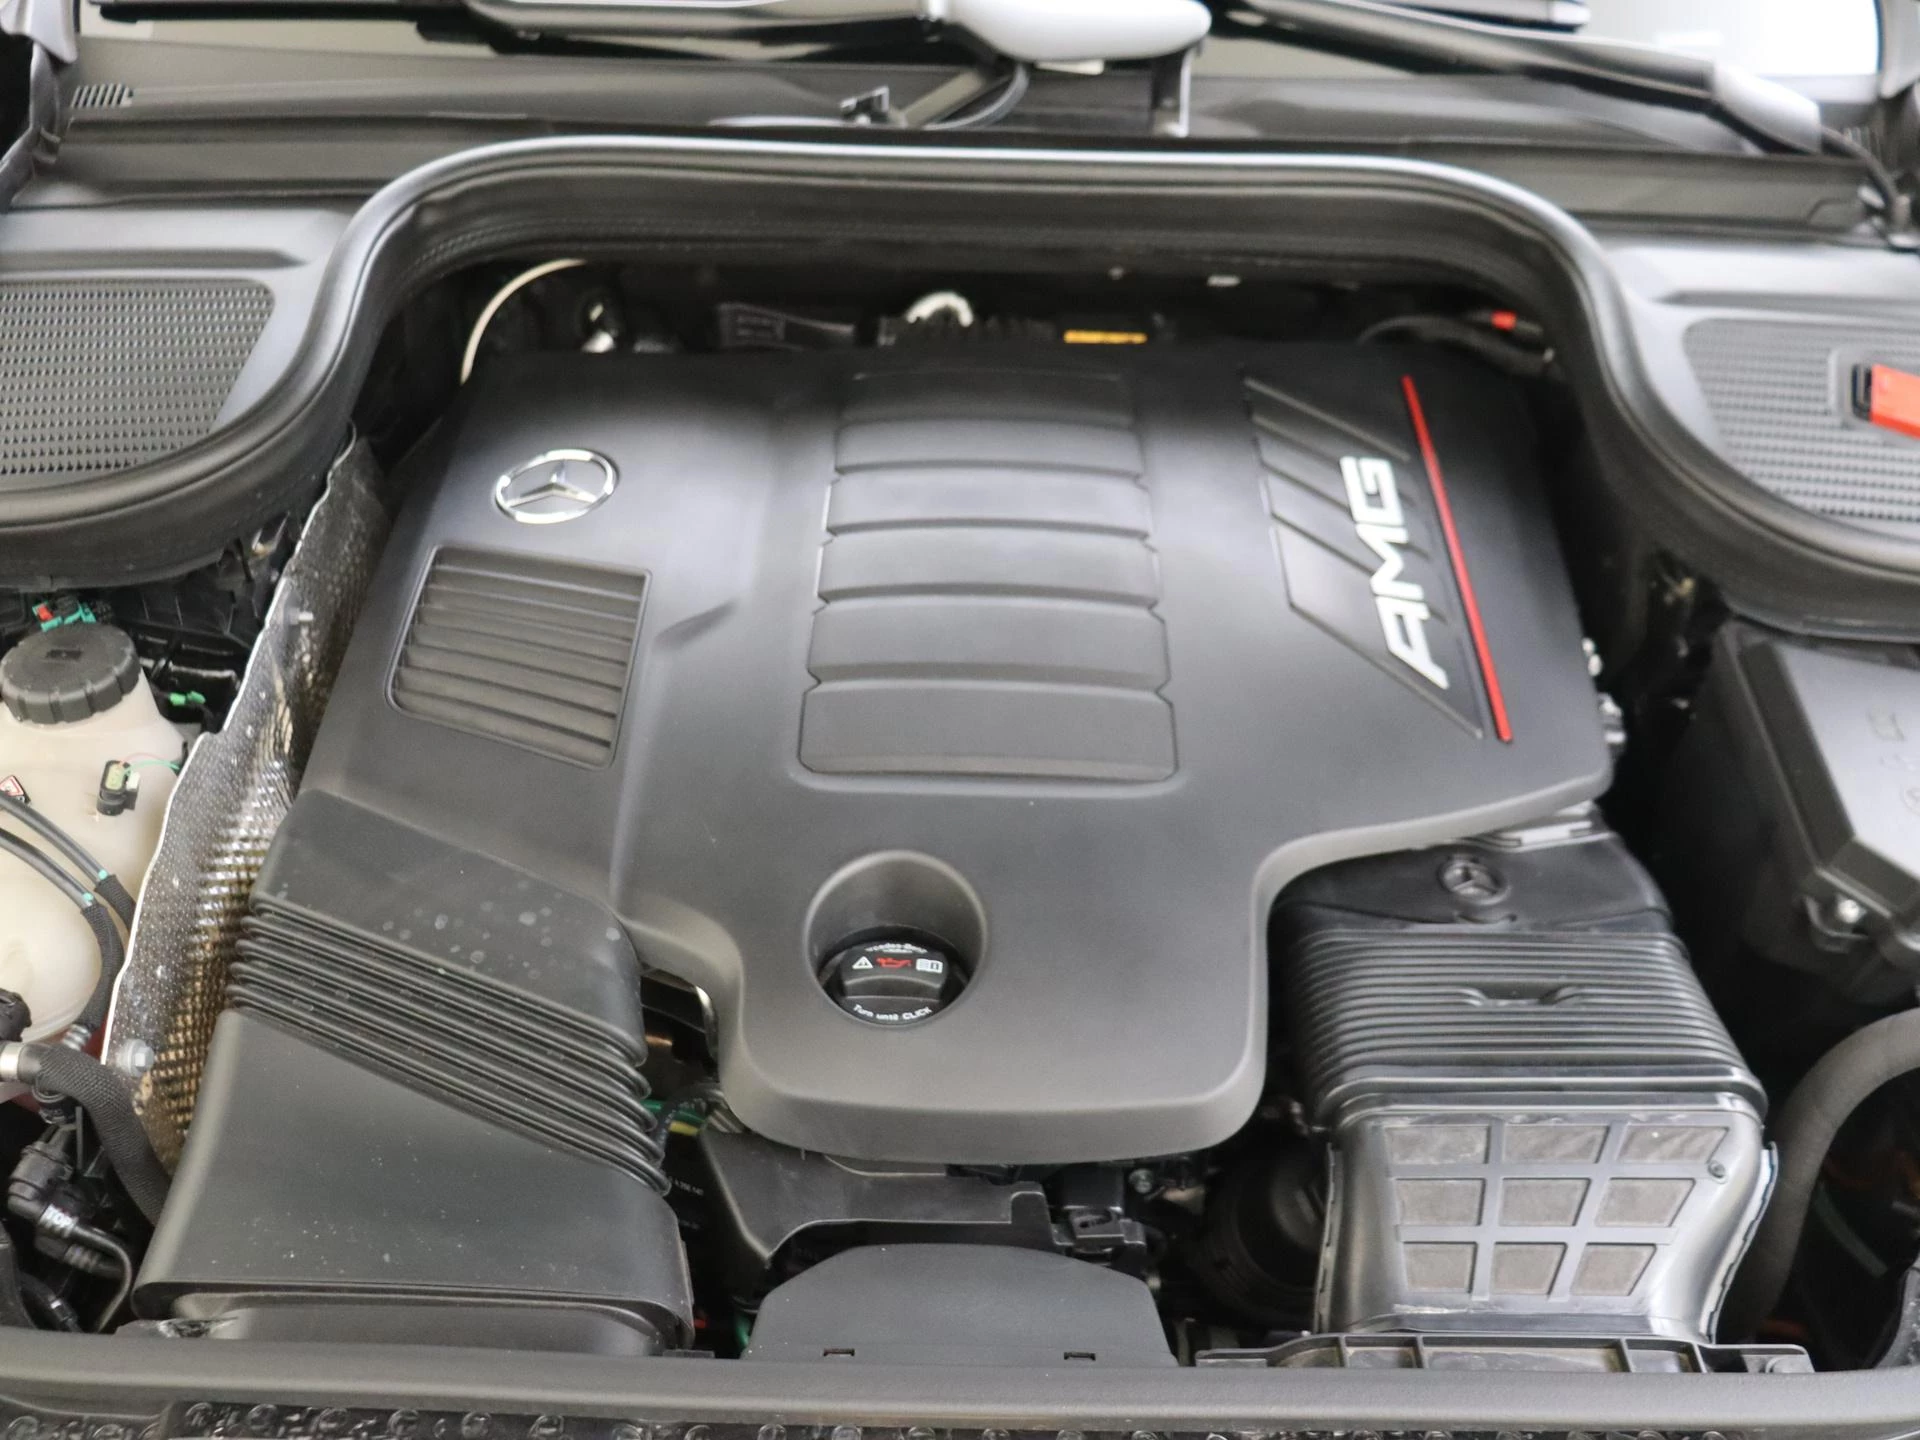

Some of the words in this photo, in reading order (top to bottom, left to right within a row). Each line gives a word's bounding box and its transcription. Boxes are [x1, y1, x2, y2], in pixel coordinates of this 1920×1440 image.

[1339, 455, 1450, 690] AMG
[853, 1004, 874, 1017] Turn
[875, 1013, 899, 1021] until
[902, 1007, 932, 1020] CLICK
[46, 1206, 72, 1228] TOP
